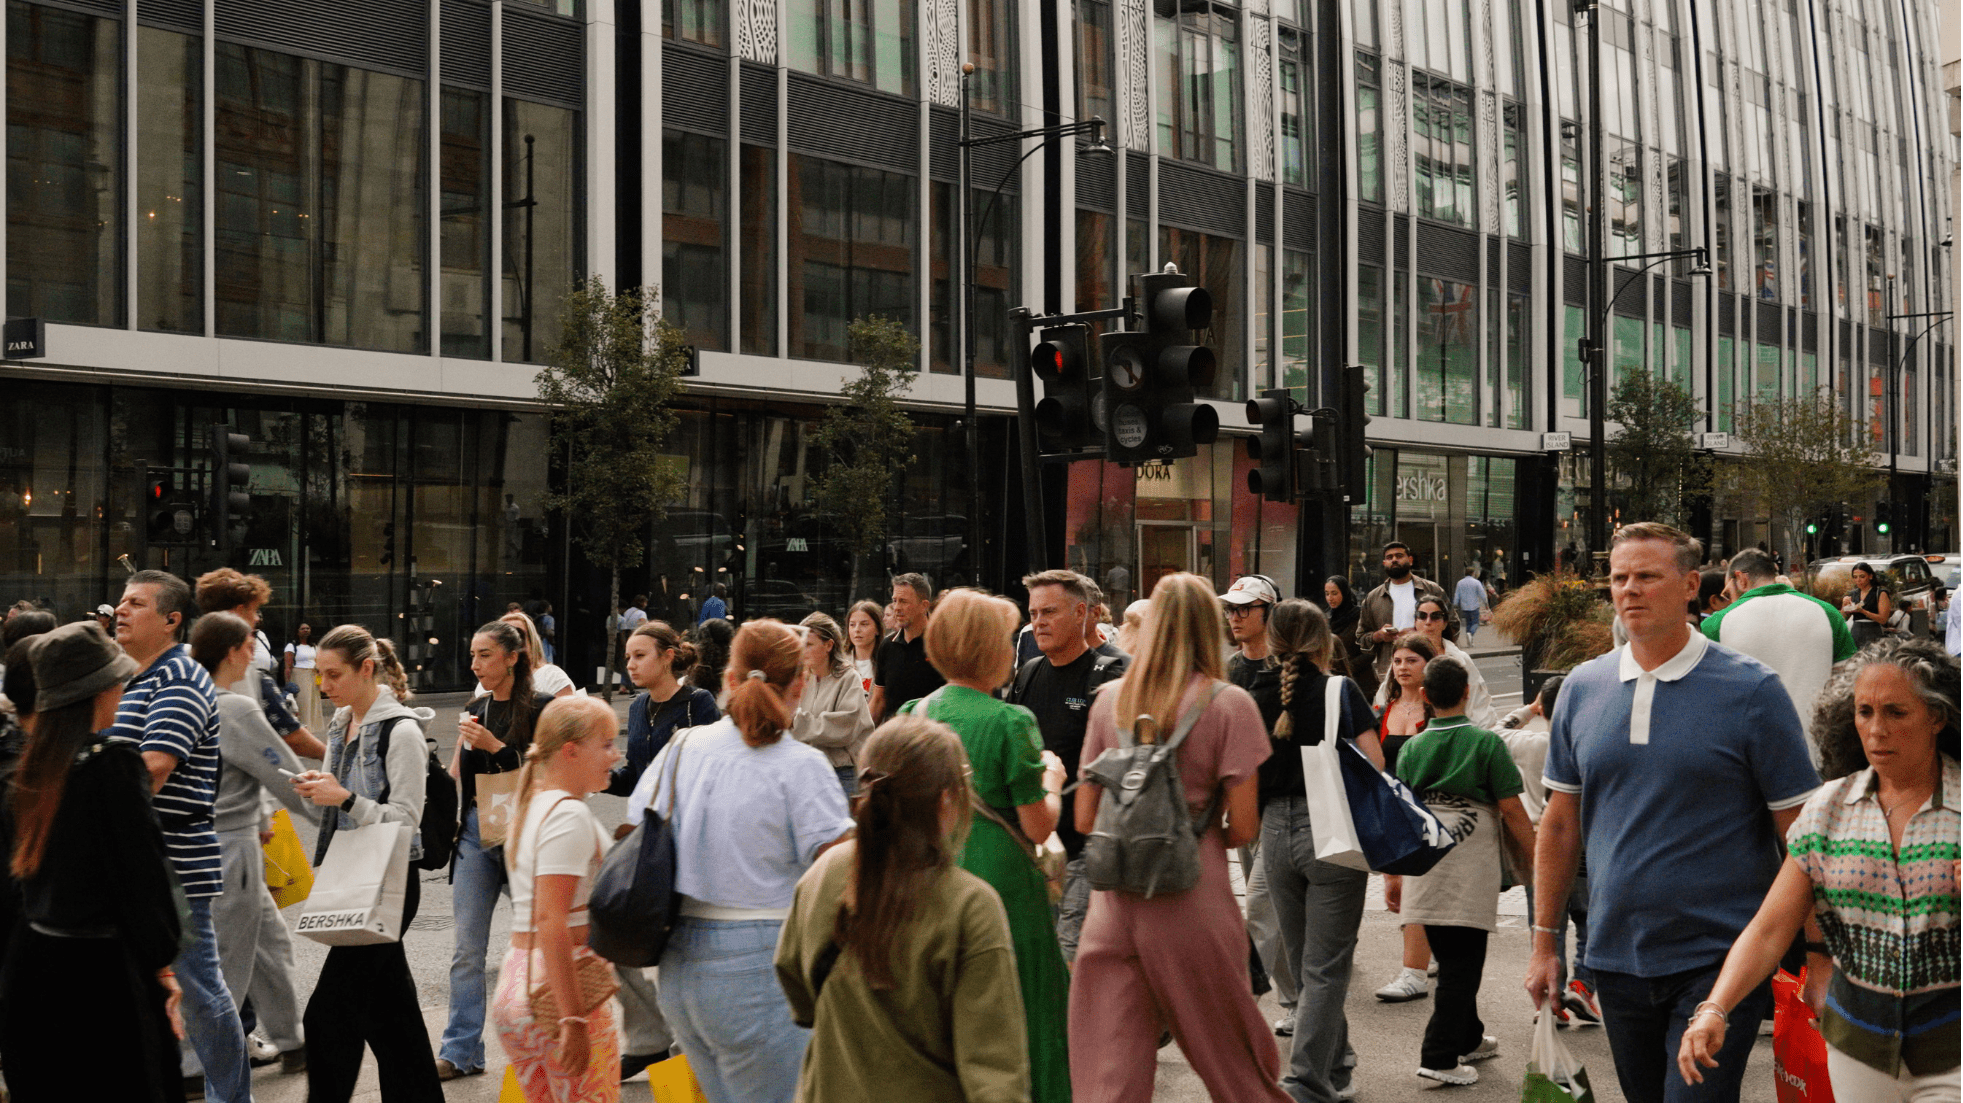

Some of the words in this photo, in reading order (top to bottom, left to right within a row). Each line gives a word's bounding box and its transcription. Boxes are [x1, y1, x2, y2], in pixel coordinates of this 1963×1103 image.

[7, 340, 34, 351] ZARA
[1120, 435, 1142, 445] cycles
[1545, 441, 1569, 449] ISLAND
[786, 537, 809, 552] ZARA
[248, 548, 284, 566] ZARA
[298, 912, 365, 931] BERSHKA
